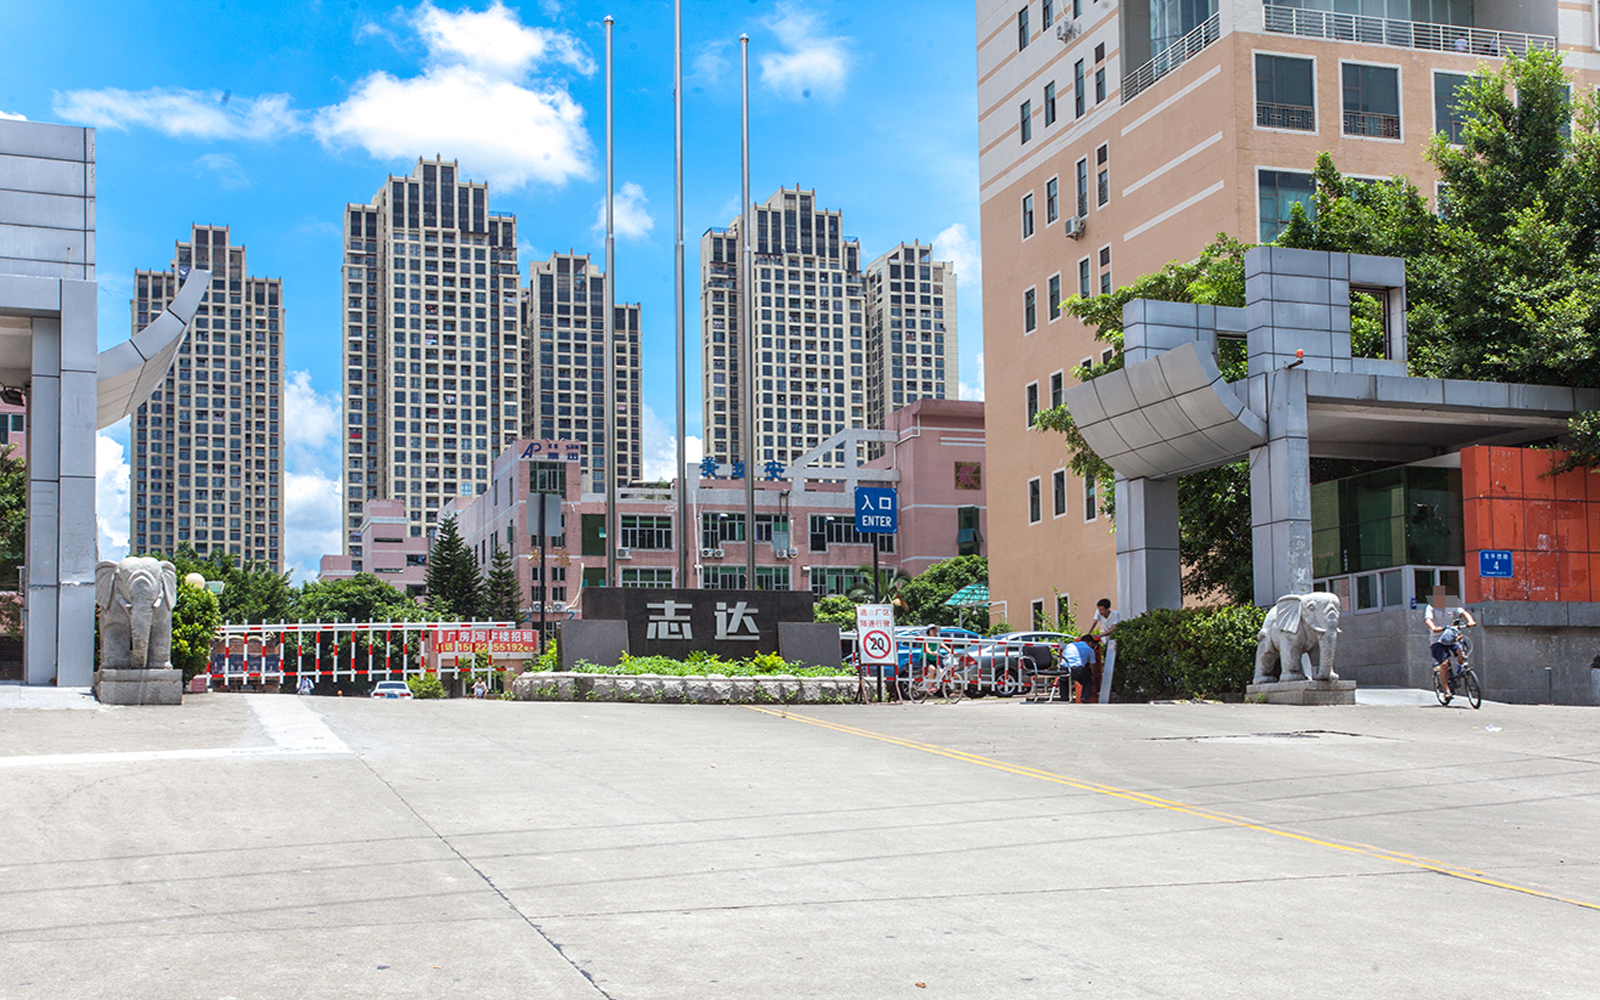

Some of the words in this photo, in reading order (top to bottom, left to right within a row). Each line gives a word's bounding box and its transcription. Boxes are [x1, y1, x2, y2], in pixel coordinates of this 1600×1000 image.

[861, 494, 891, 510] 入口
[862, 515, 892, 527] ENTER
[1493, 561, 1499, 570] 4
[646, 600, 760, 640] 志达
[860, 619, 890, 628] 限速行驶
[458, 643, 524, 651] 152255192
[870, 637, 884, 650] 20
